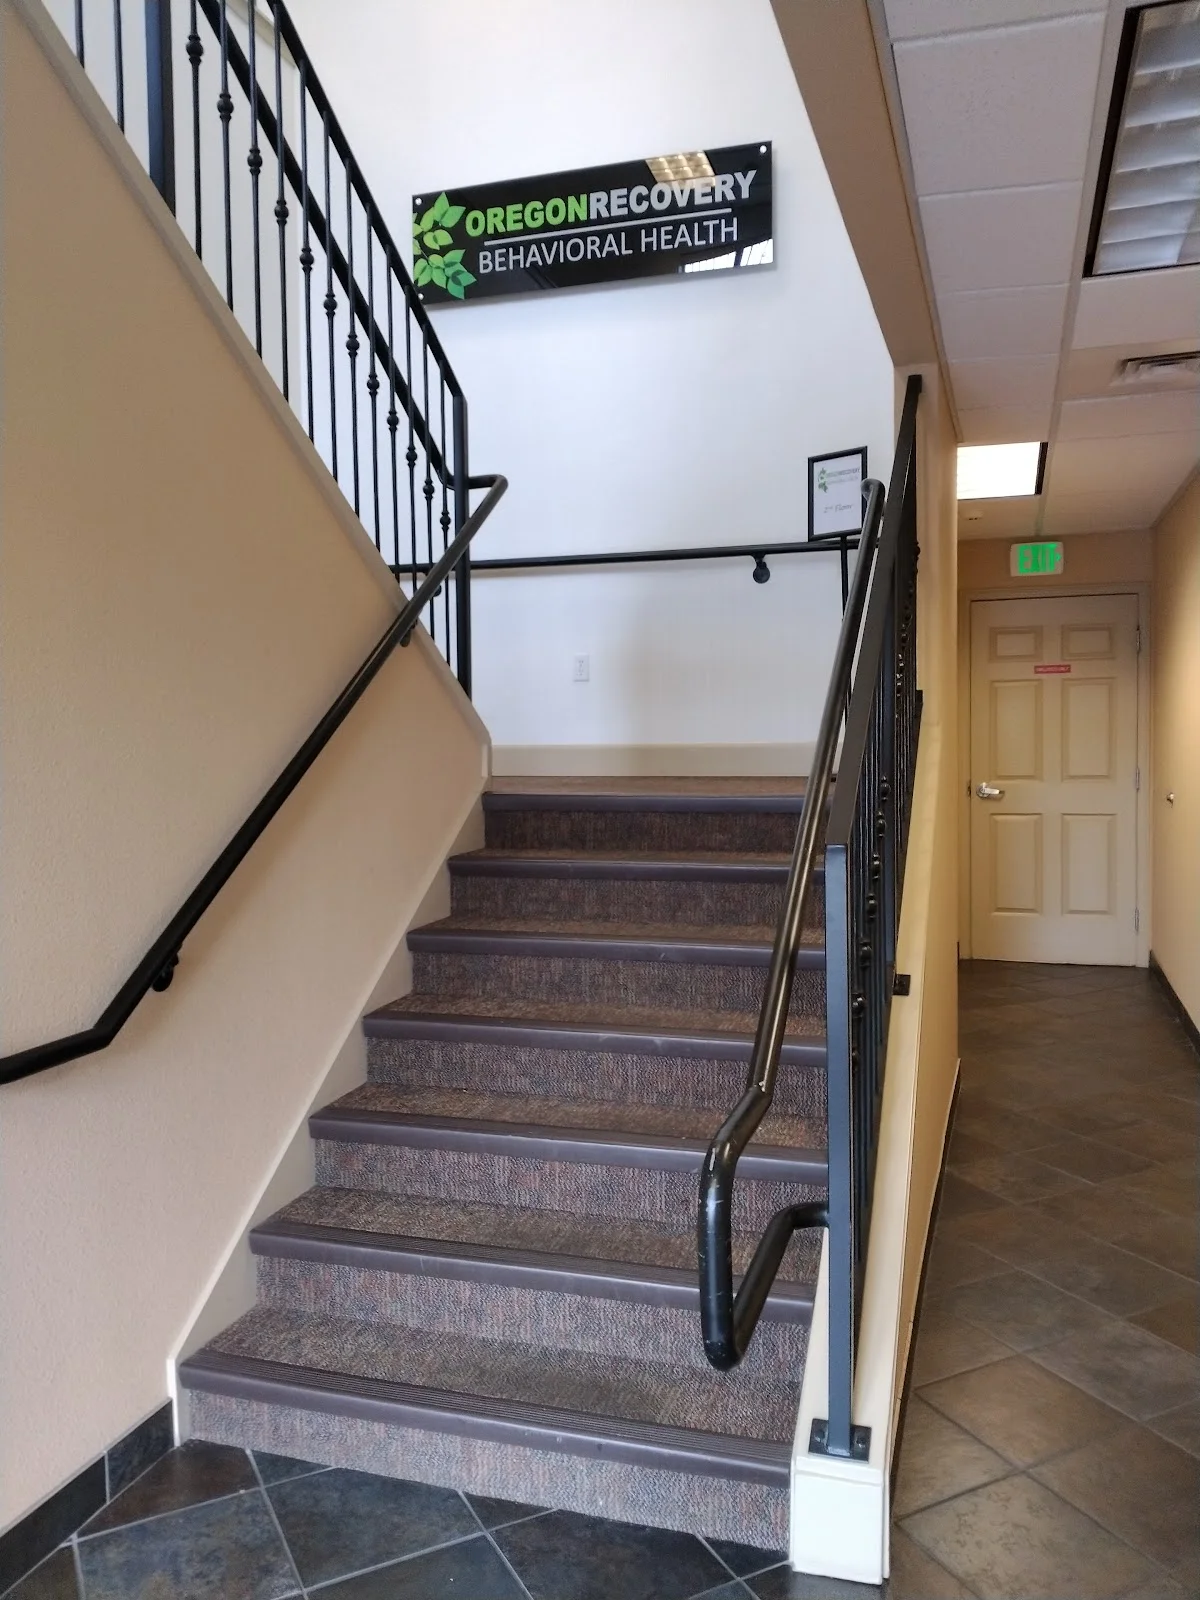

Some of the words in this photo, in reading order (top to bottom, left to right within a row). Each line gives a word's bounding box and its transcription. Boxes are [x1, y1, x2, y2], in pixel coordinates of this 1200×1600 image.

[478, 232, 633, 274] BEHAVIORAL
[641, 217, 739, 253] HEALTH
[1018, 543, 1056, 573] EXIT
